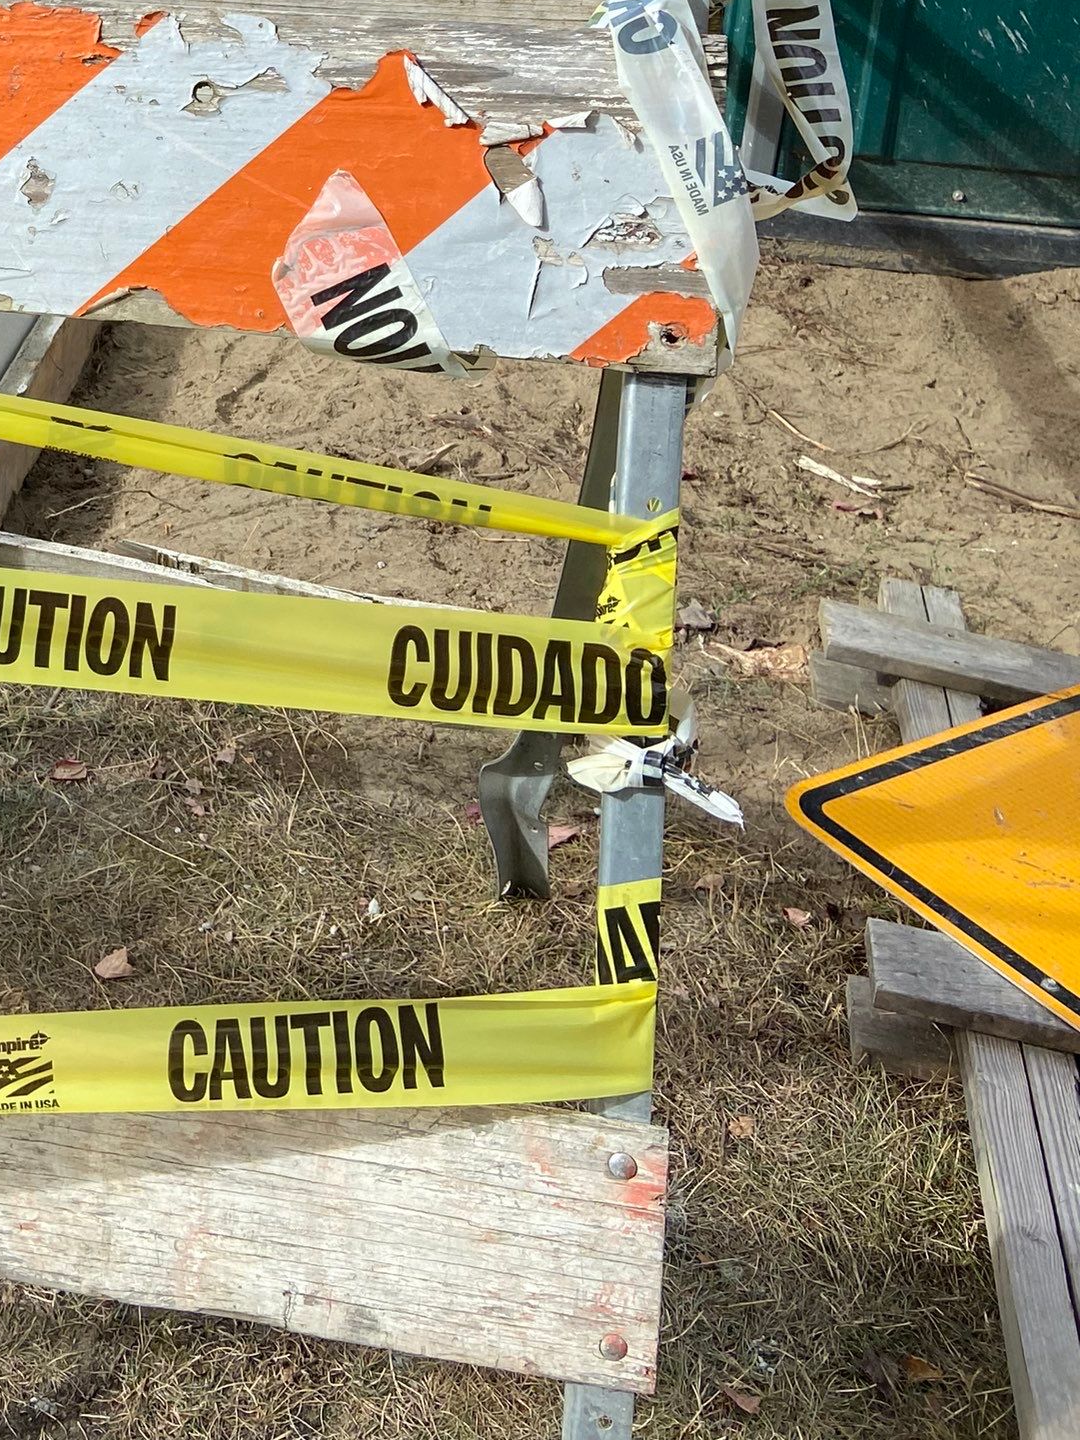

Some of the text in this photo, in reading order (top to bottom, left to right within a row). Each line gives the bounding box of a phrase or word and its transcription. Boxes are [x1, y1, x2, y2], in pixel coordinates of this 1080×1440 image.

[387, 624, 668, 727] CUIDADO
[168, 1002, 446, 1103] CAUTION
[19, 1100, 33, 1110] IN
[34, 1098, 61, 1110] USA
